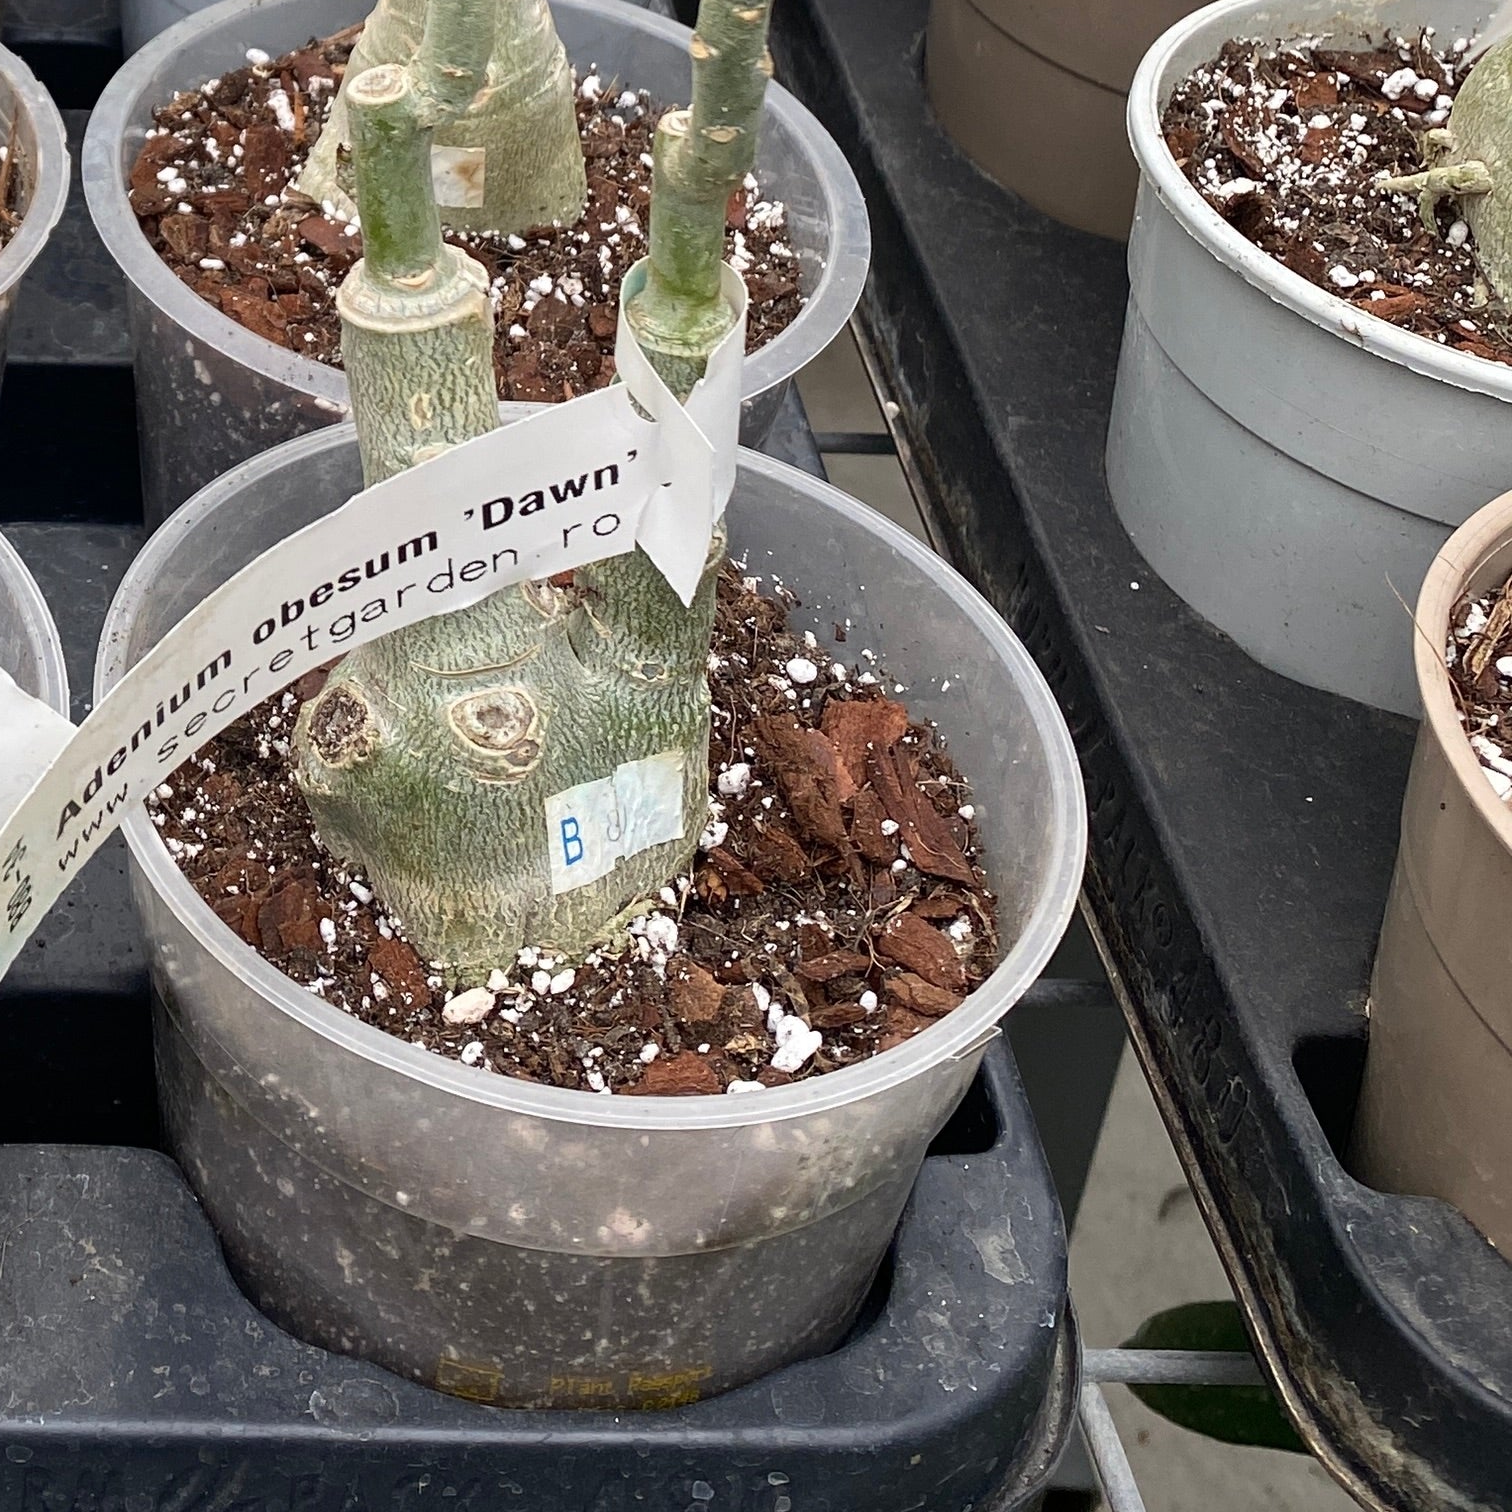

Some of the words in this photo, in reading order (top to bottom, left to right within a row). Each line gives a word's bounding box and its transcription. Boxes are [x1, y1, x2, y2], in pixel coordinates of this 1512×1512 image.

[56, 647, 232, 841] Adenium
[252, 526, 439, 647] obesum
[463, 449, 639, 532] 'Dawn'
[560, 816, 584, 866] B
